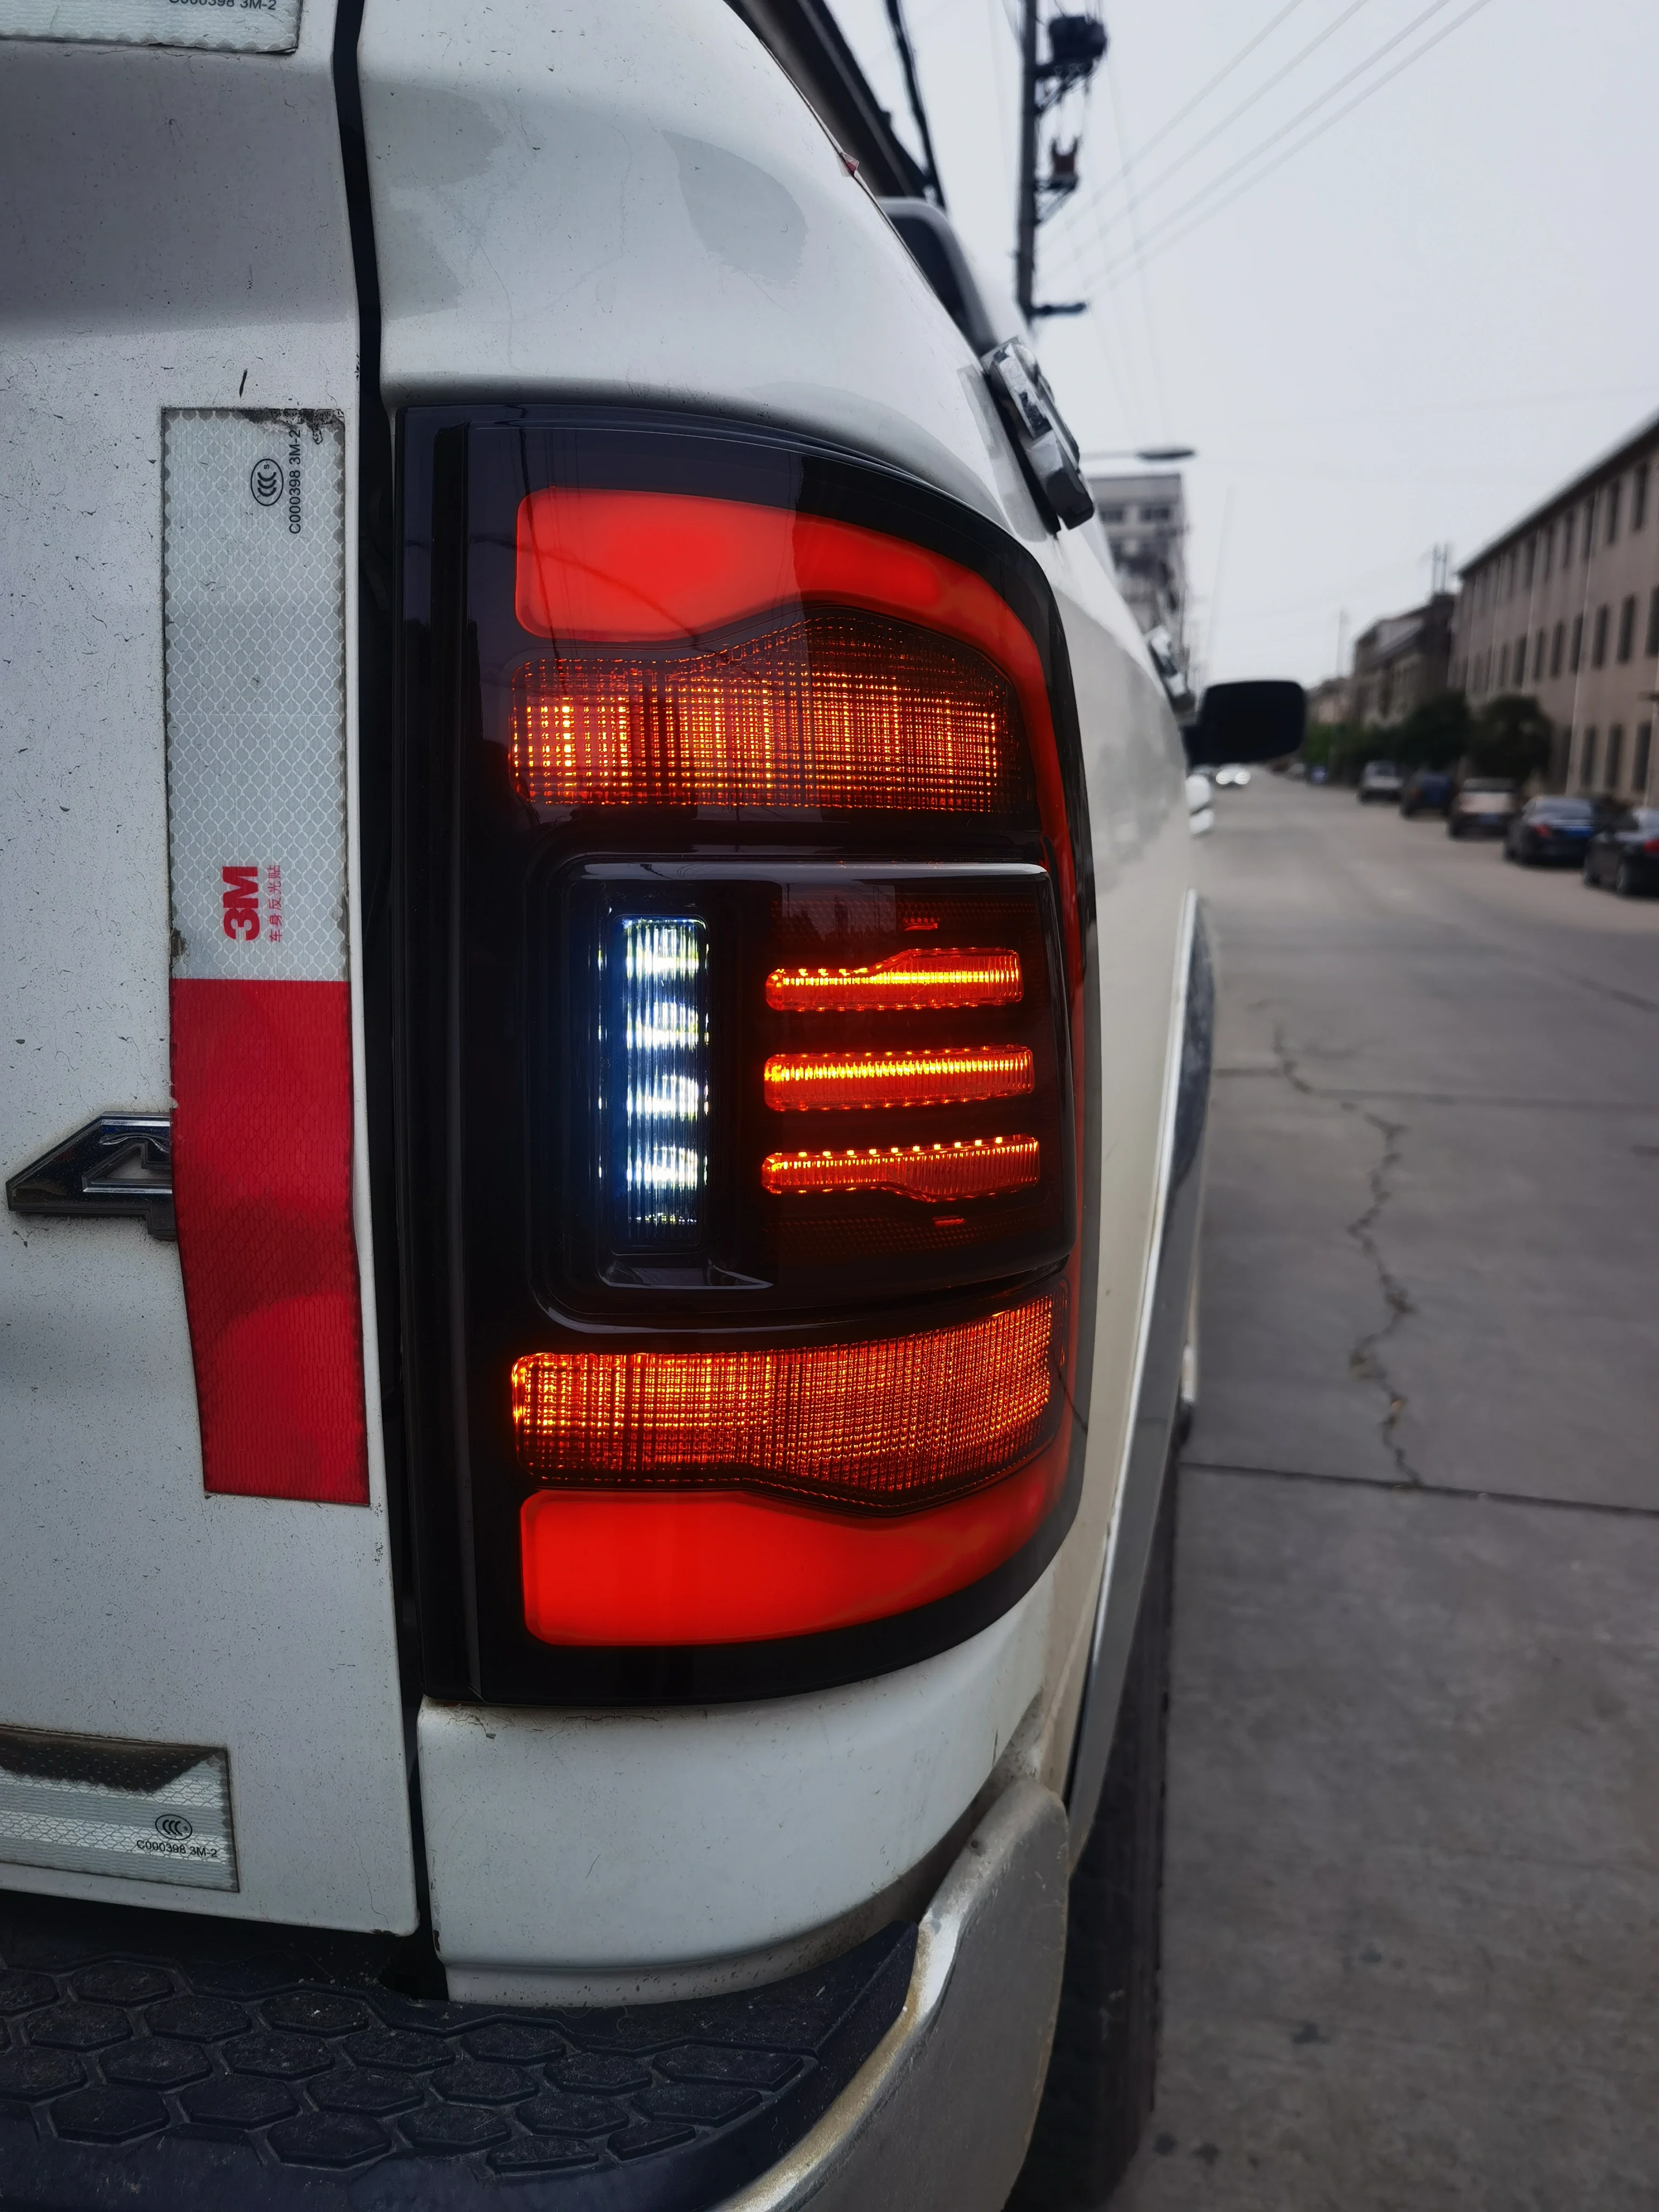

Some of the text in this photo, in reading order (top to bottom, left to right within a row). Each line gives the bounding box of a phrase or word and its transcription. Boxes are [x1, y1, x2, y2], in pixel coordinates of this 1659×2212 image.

[289, 429, 301, 534] C000398 3M-2
[222, 866, 260, 941] 3M
[267, 865, 283, 943] 车身反光贴
[136, 1839, 219, 1858] C000398 3M-2
